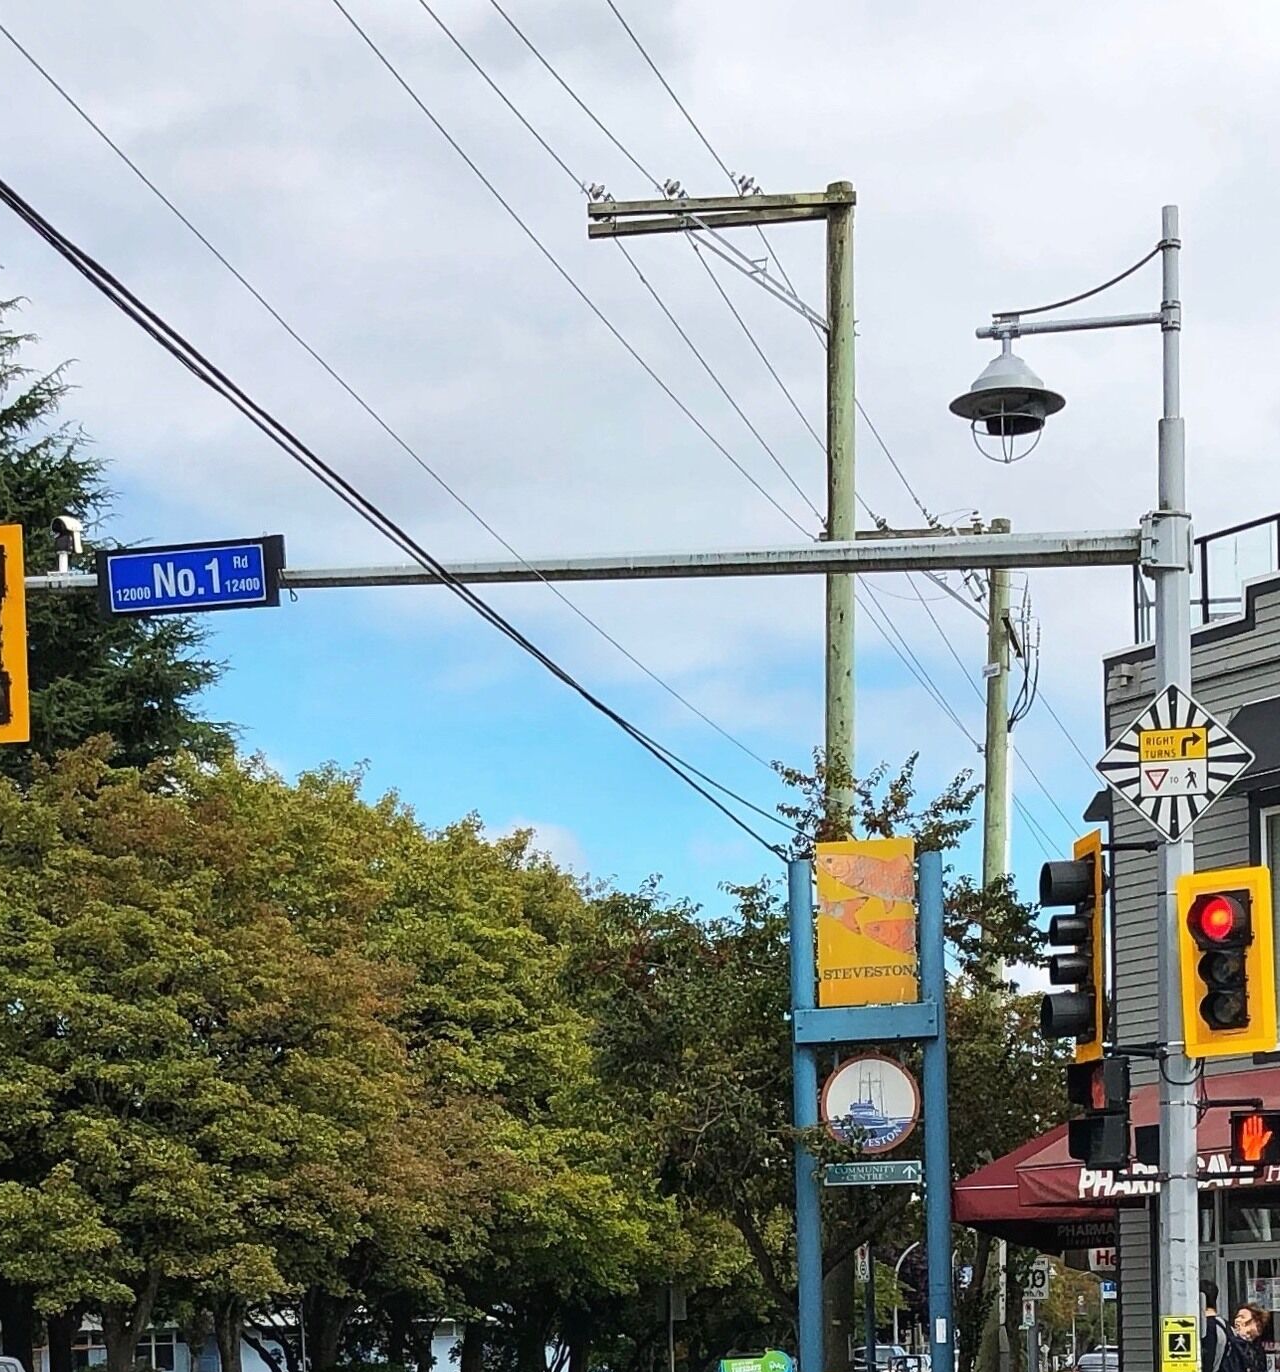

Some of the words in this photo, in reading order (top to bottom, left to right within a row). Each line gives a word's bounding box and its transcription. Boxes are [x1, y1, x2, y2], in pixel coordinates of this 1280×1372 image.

[153, 558, 220, 598] No.1
[233, 555, 248, 569] Rd
[225, 577, 260, 593] 12400
[116, 586, 151, 602] 12000
[1145, 735, 1175, 746] RIGHT
[1144, 749, 1176, 759] TURNS
[1170, 776, 1179, 784] TO
[823, 964, 914, 980] STEVESTON
